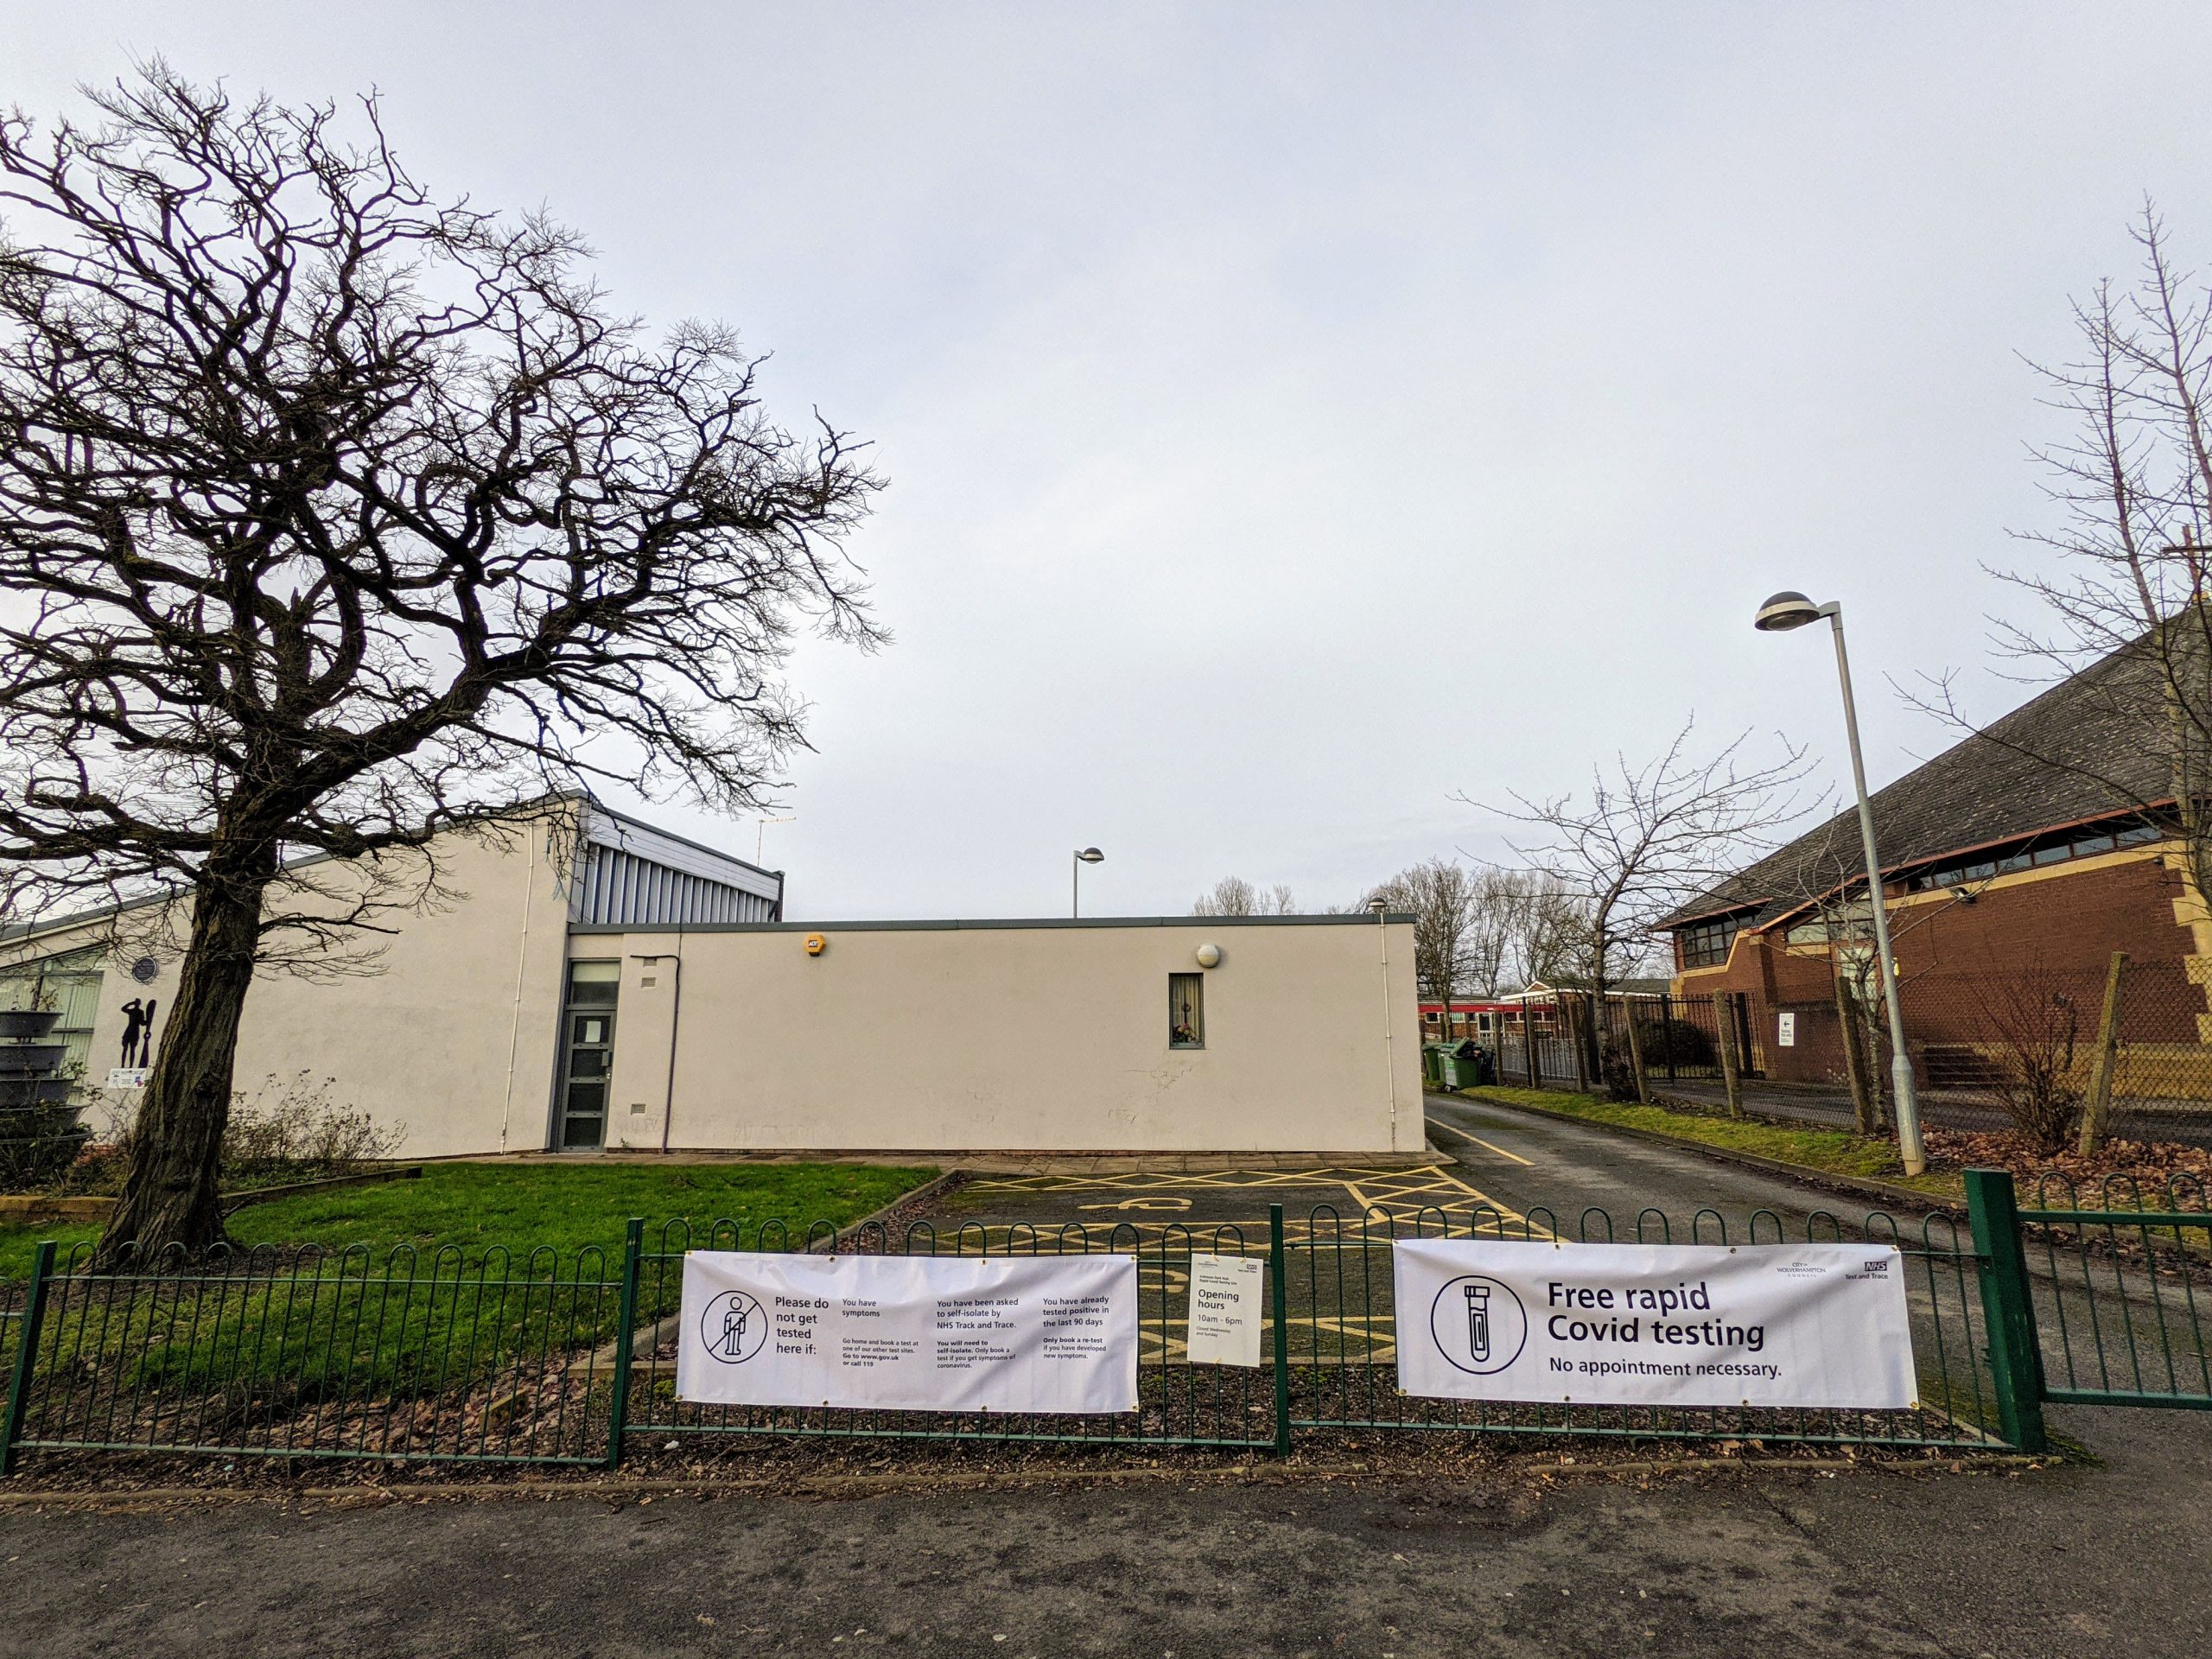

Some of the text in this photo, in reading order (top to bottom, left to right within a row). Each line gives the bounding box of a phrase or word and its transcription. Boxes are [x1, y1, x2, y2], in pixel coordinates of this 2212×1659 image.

[1865, 1262, 1887, 1271] NHS
[1080, 1296, 1109, 1305] already
[1198, 1289, 1239, 1302] Opening
[1548, 1281, 1710, 1317] Free rapid
[776, 1297, 829, 1308] Please do
[1198, 1300, 1224, 1310] hours
[992, 1309, 1001, 1319] by
[1069, 1307, 1100, 1316] positive
[777, 1313, 817, 1325] not get
[1085, 1318, 1103, 1326] days
[1198, 1314, 1217, 1323] 10am
[1225, 1317, 1243, 1325] 6pm
[777, 1328, 811, 1338] tested
[1548, 1315, 1764, 1351] Covid testing
[777, 1343, 817, 1354] here if:
[1550, 1357, 1782, 1380] No appointment necessary.
